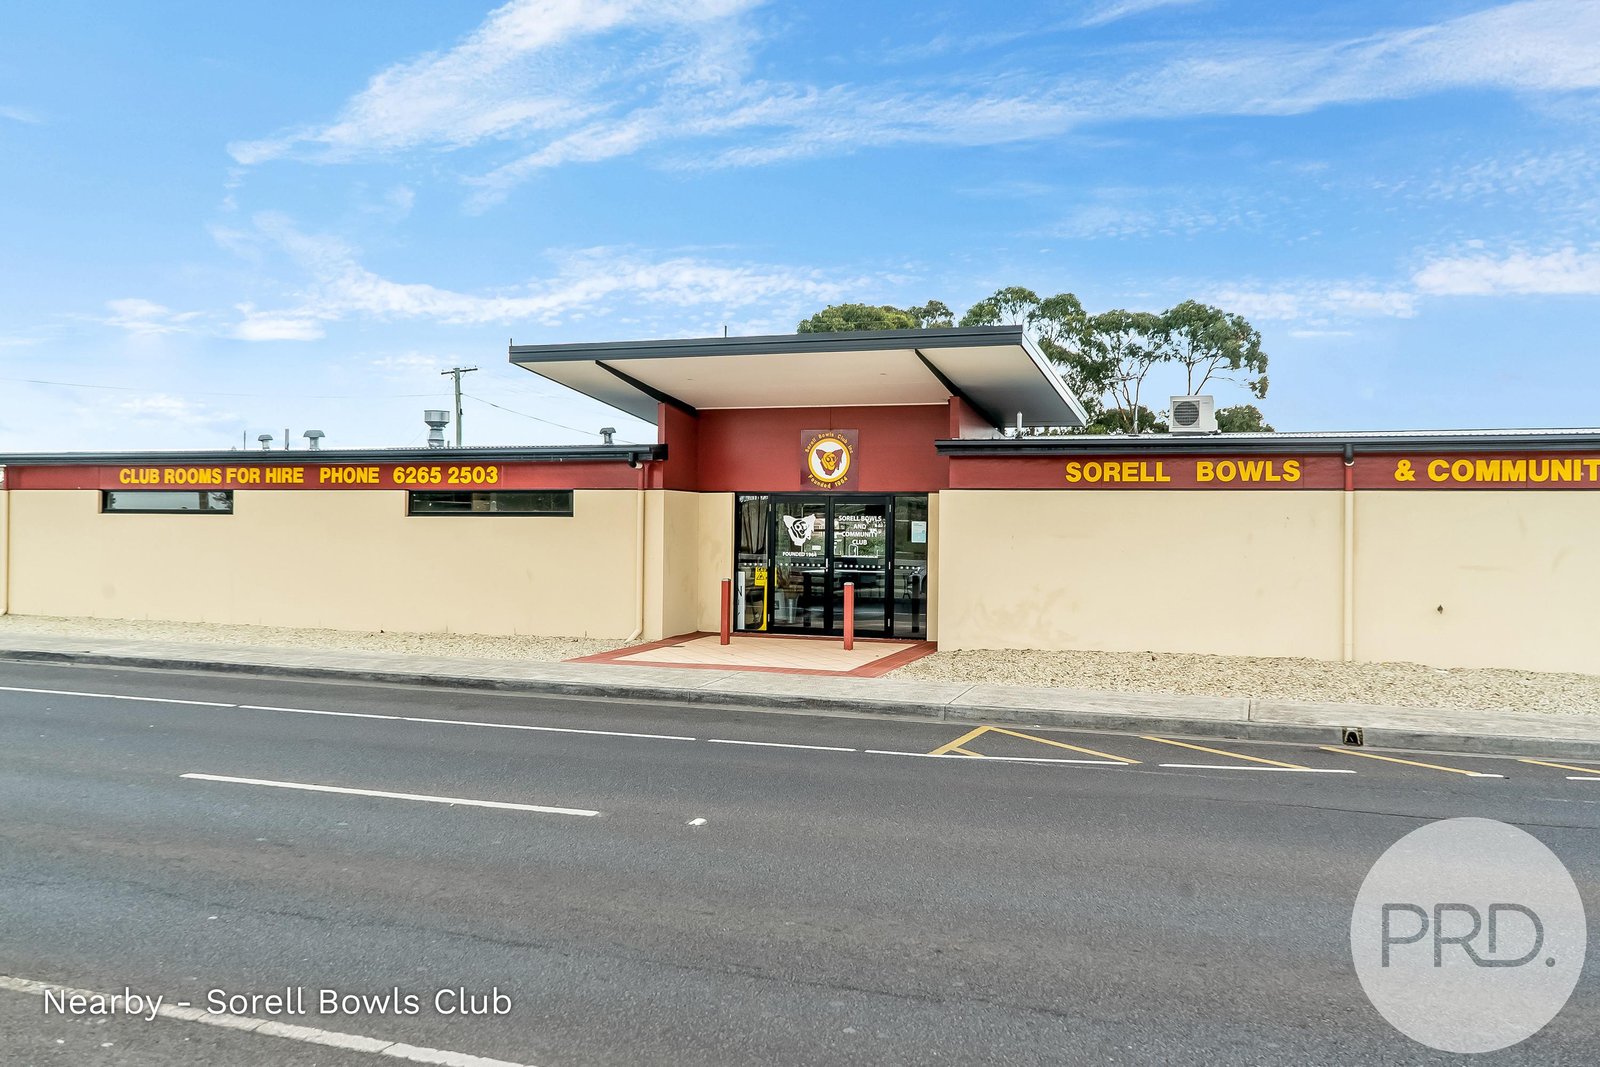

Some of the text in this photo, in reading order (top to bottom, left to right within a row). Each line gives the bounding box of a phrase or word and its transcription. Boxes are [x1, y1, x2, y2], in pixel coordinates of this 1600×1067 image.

[837, 434, 848, 444] Club
[118, 465, 499, 485] CLUB ROOMS FOR HIRE PHONE 6265 2503
[1065, 458, 1600, 483] SORELL BOWLS & COMMUNIT
[808, 474, 832, 489] Founded
